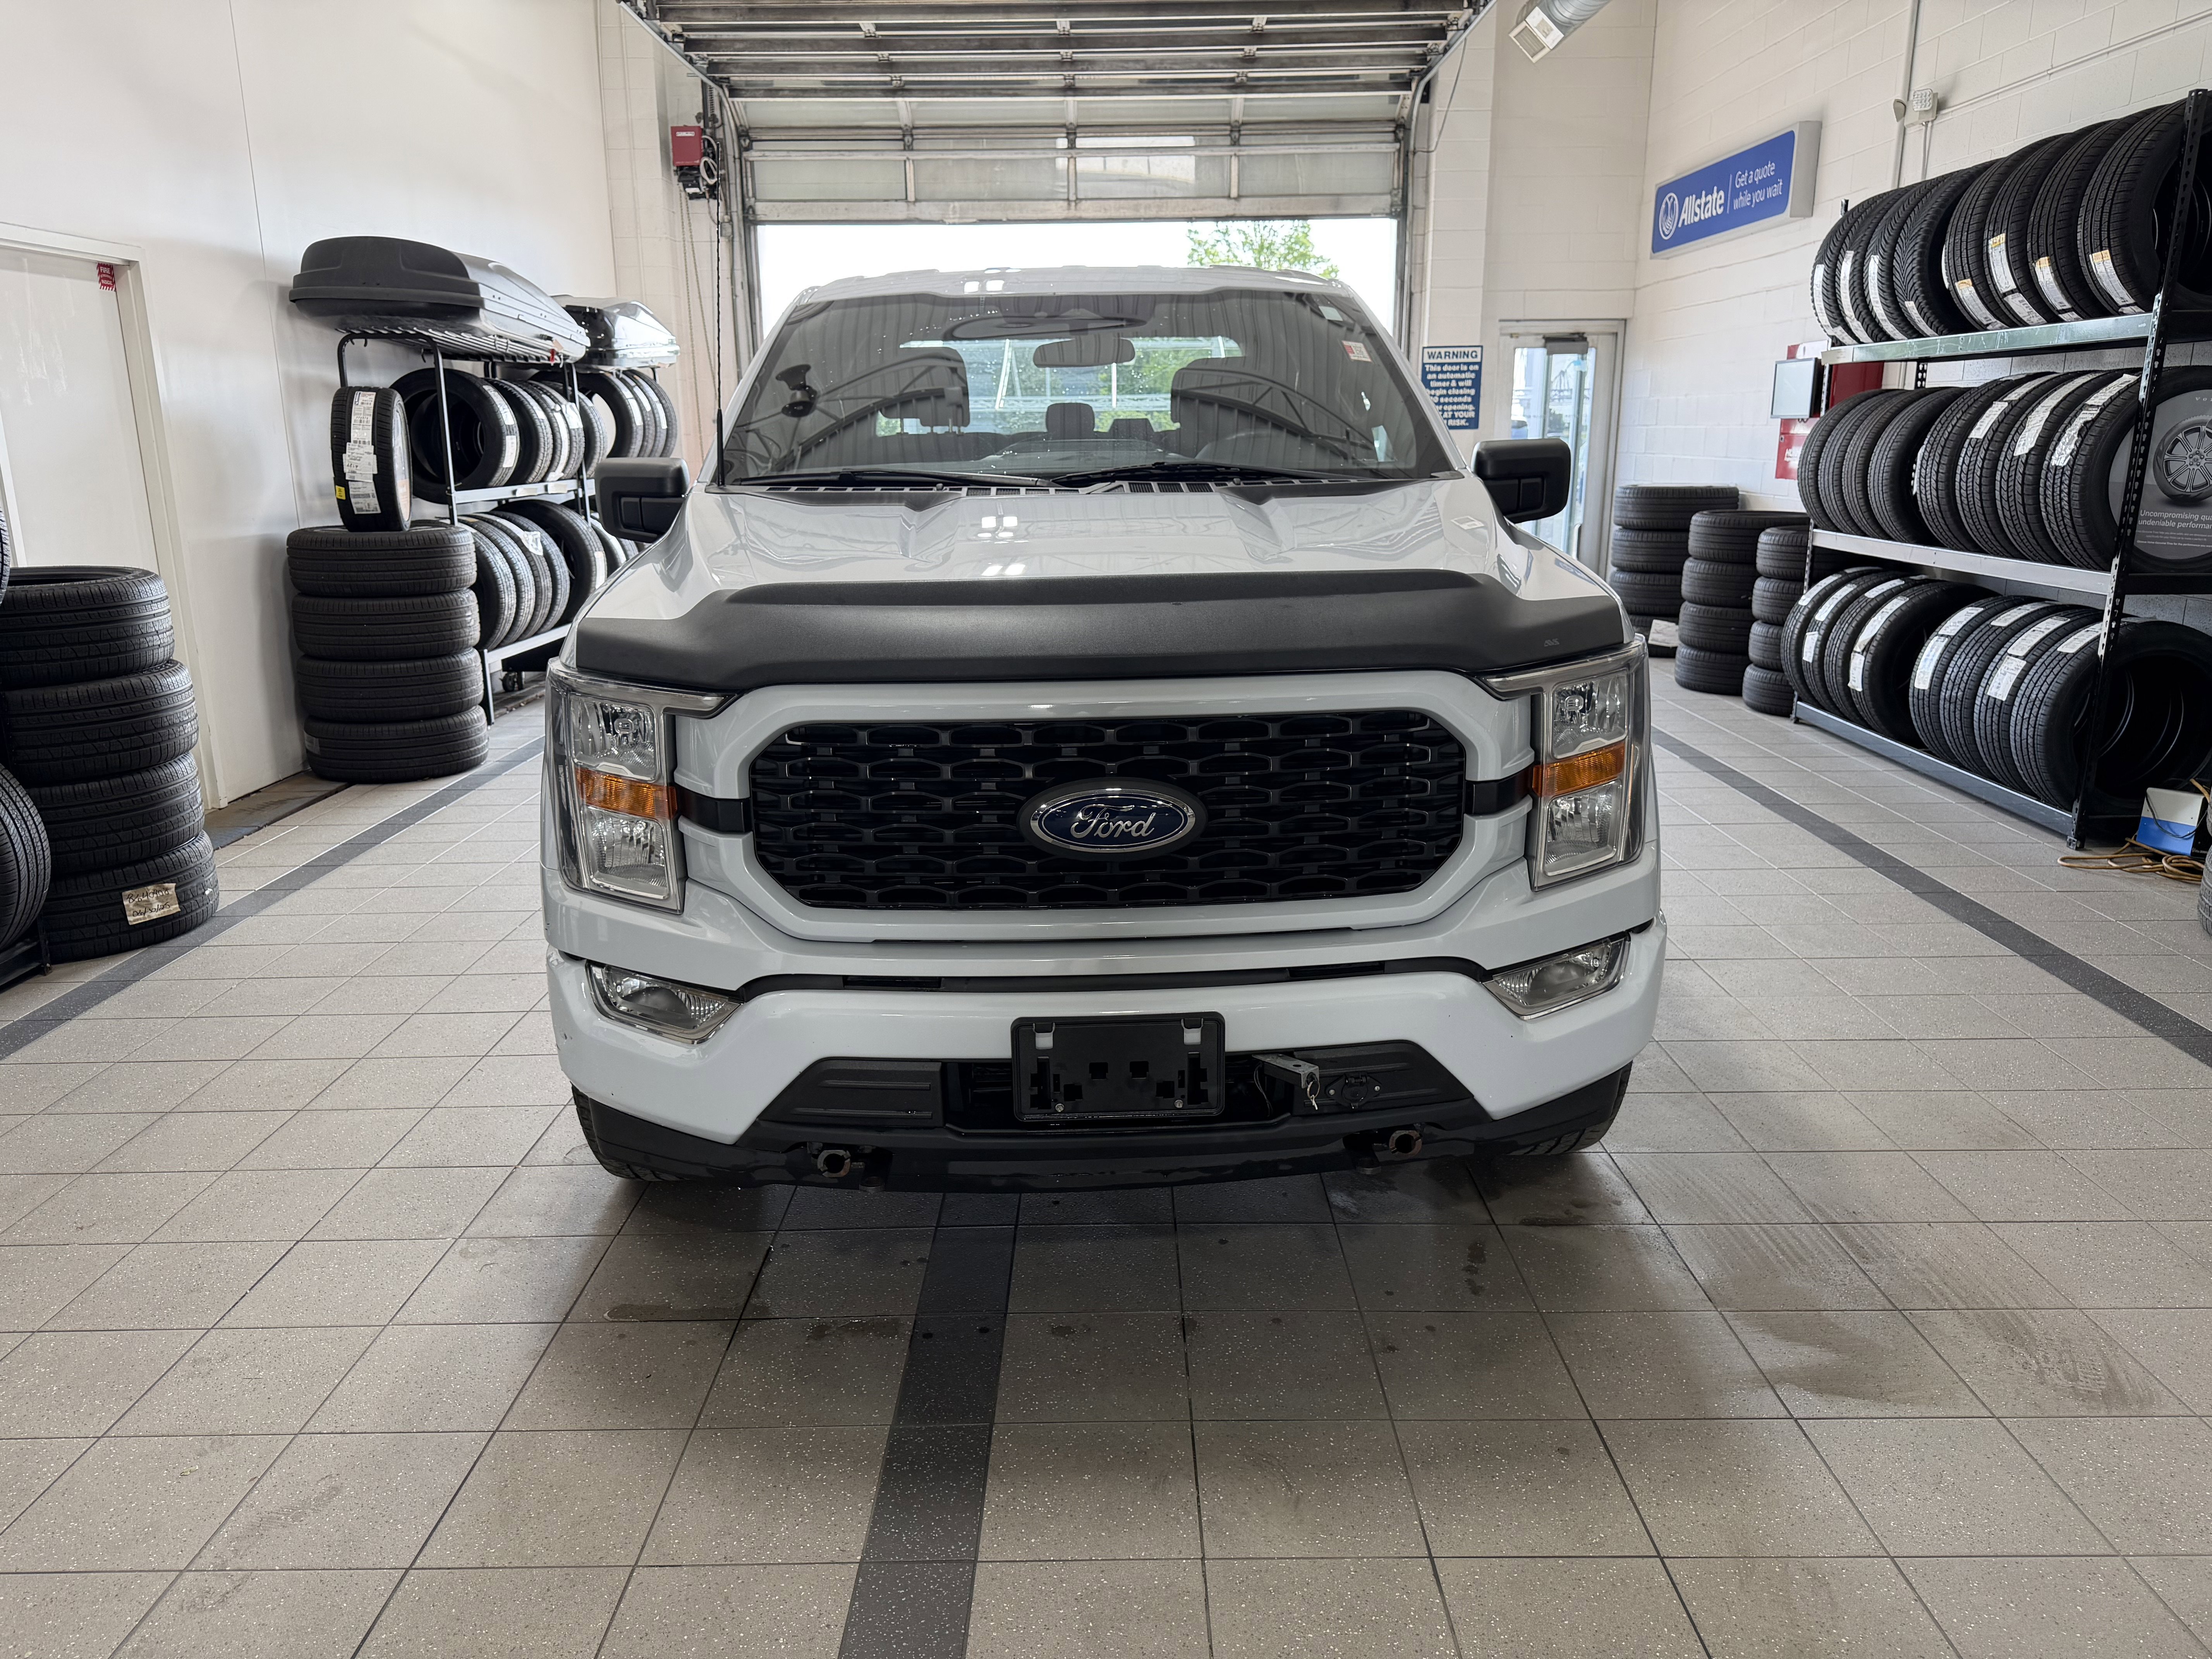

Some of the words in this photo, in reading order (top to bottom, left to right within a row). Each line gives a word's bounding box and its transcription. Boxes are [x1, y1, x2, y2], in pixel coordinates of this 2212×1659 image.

[1735, 170, 1748, 188] Get
[1748, 171, 1753, 184] a
[1754, 160, 1776, 184] quote
[1678, 186, 1724, 227] Allstate
[1733, 189, 1751, 210] while
[1752, 188, 1765, 208] you
[1767, 179, 1783, 198] wait
[1427, 350, 1477, 359] WARNING
[2138, 519, 2176, 527] undeniable
[2140, 510, 2199, 521] Uncompromising
[1070, 804, 1156, 838] Ford
